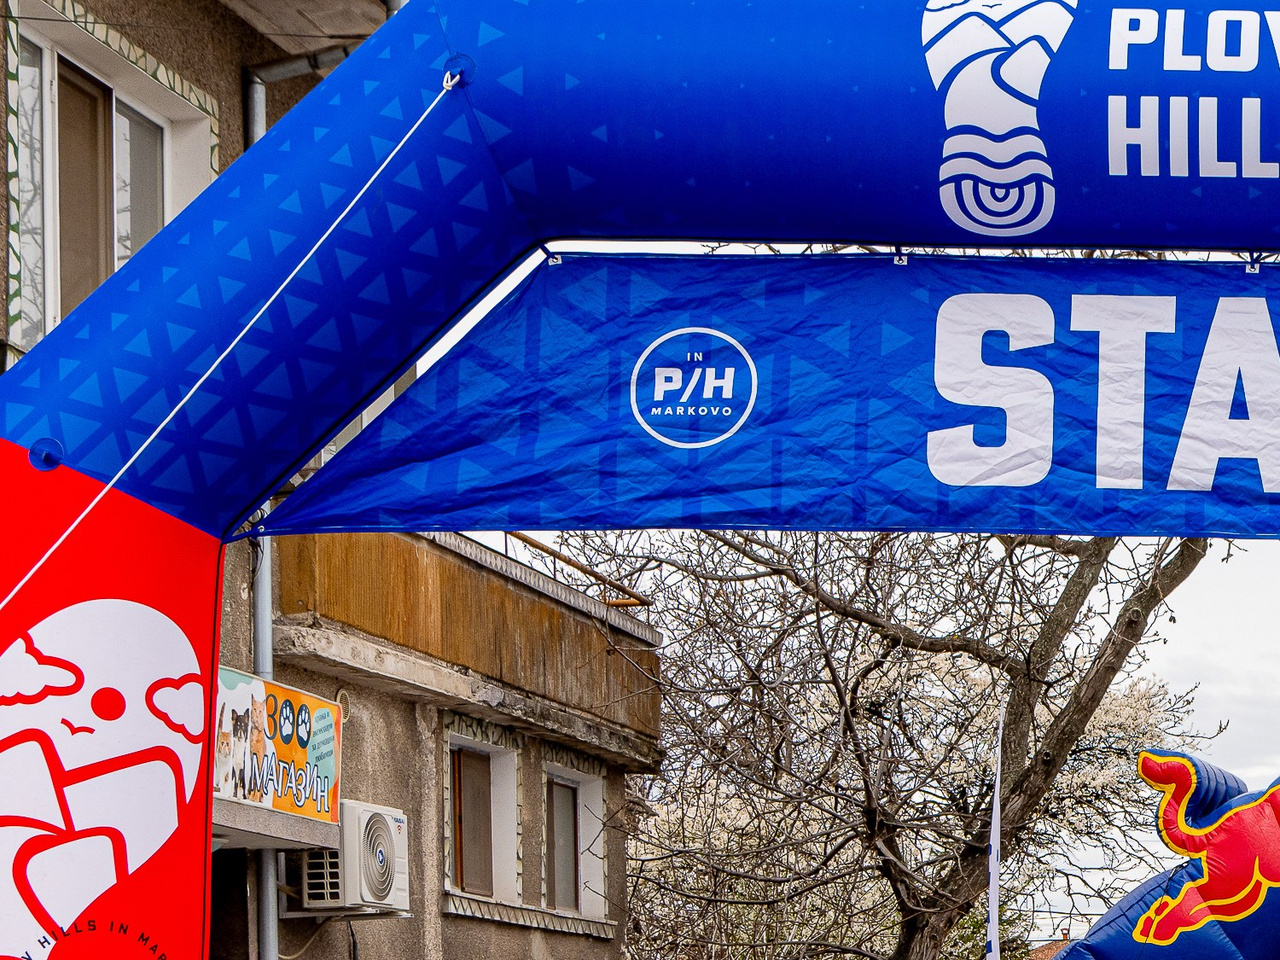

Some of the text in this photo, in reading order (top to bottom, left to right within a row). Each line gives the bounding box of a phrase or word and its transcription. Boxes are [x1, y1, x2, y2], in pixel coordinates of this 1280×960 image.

[686, 352, 703, 361] IN
[653, 367, 735, 403] P/H
[650, 406, 732, 416] MARKOVO
[250, 752, 330, 813] МАГАЗИН
[37, 919, 97, 949] HILLS
[109, 920, 129, 936] IN
